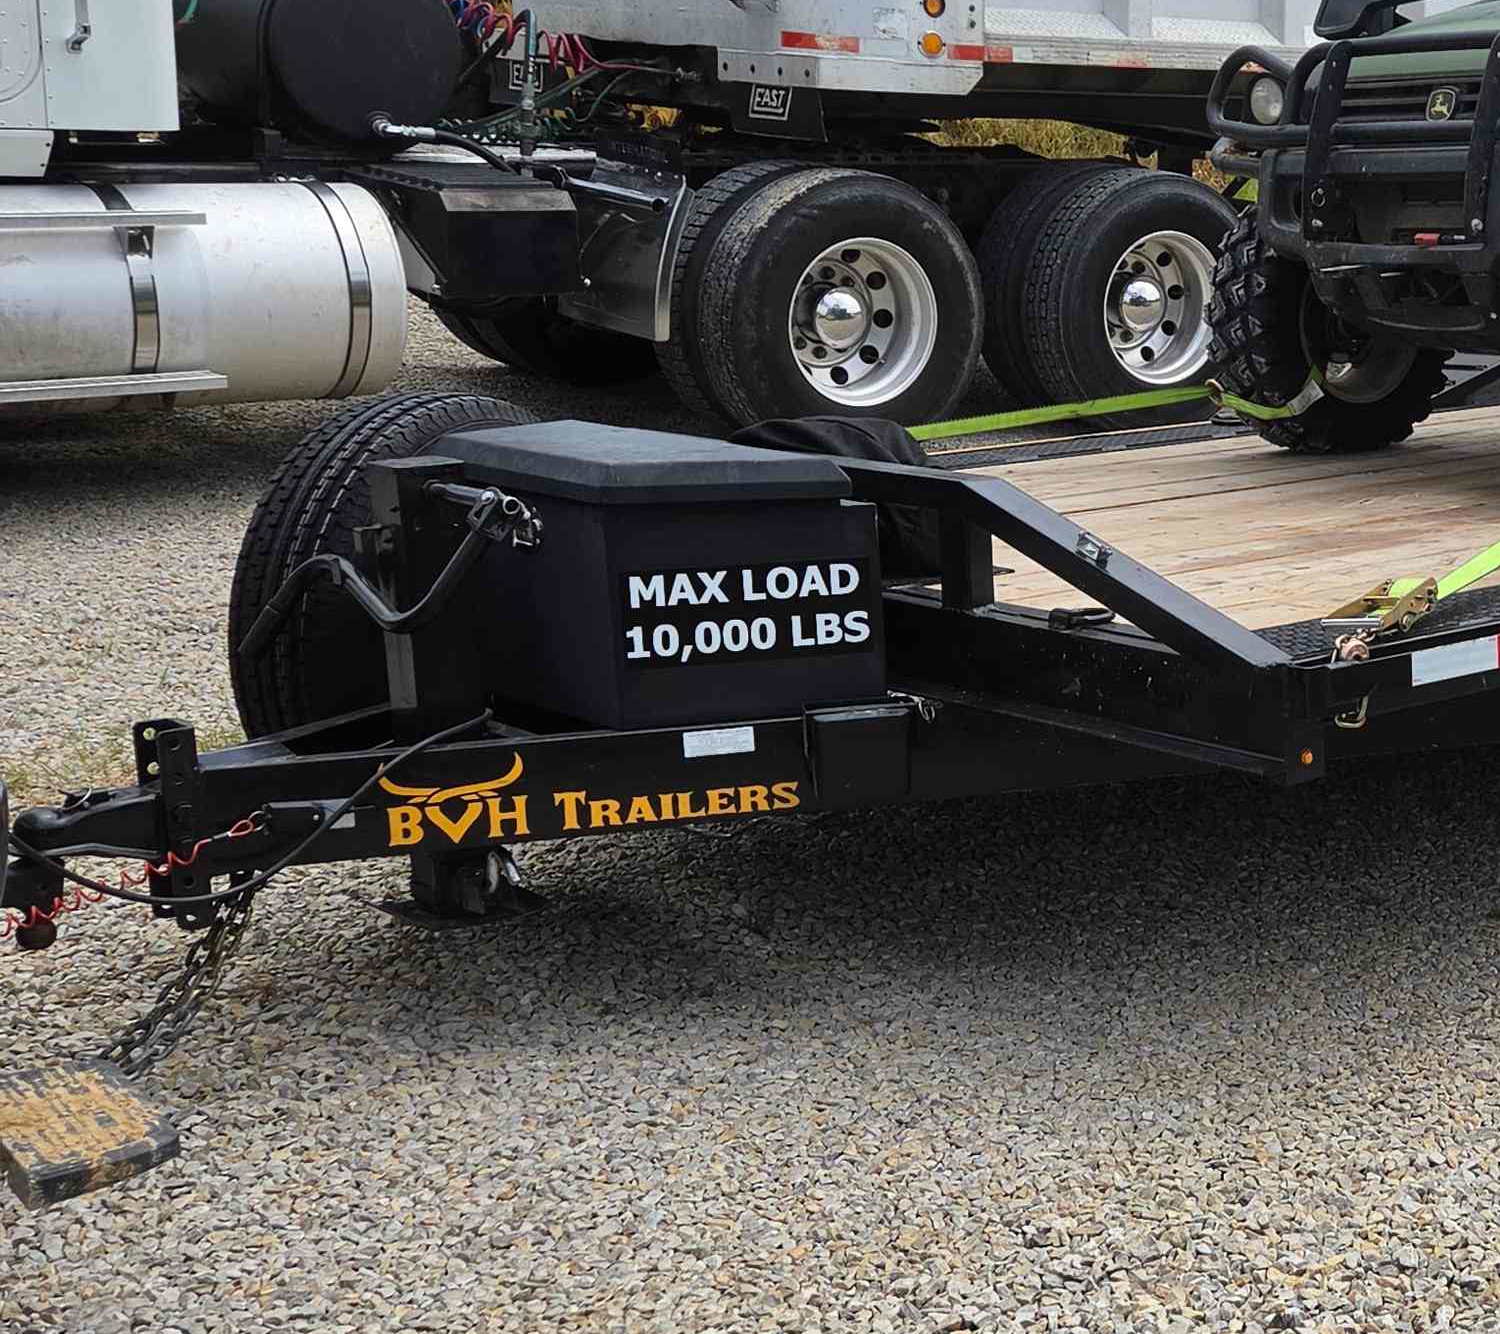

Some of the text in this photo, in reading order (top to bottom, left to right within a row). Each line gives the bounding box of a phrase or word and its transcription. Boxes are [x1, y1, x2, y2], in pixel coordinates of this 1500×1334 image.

[754, 86, 786, 107] FAST
[628, 563, 860, 609] MAX LOAD
[625, 611, 871, 663] 10,000 LBS
[553, 781, 800, 832] TRAILERS
